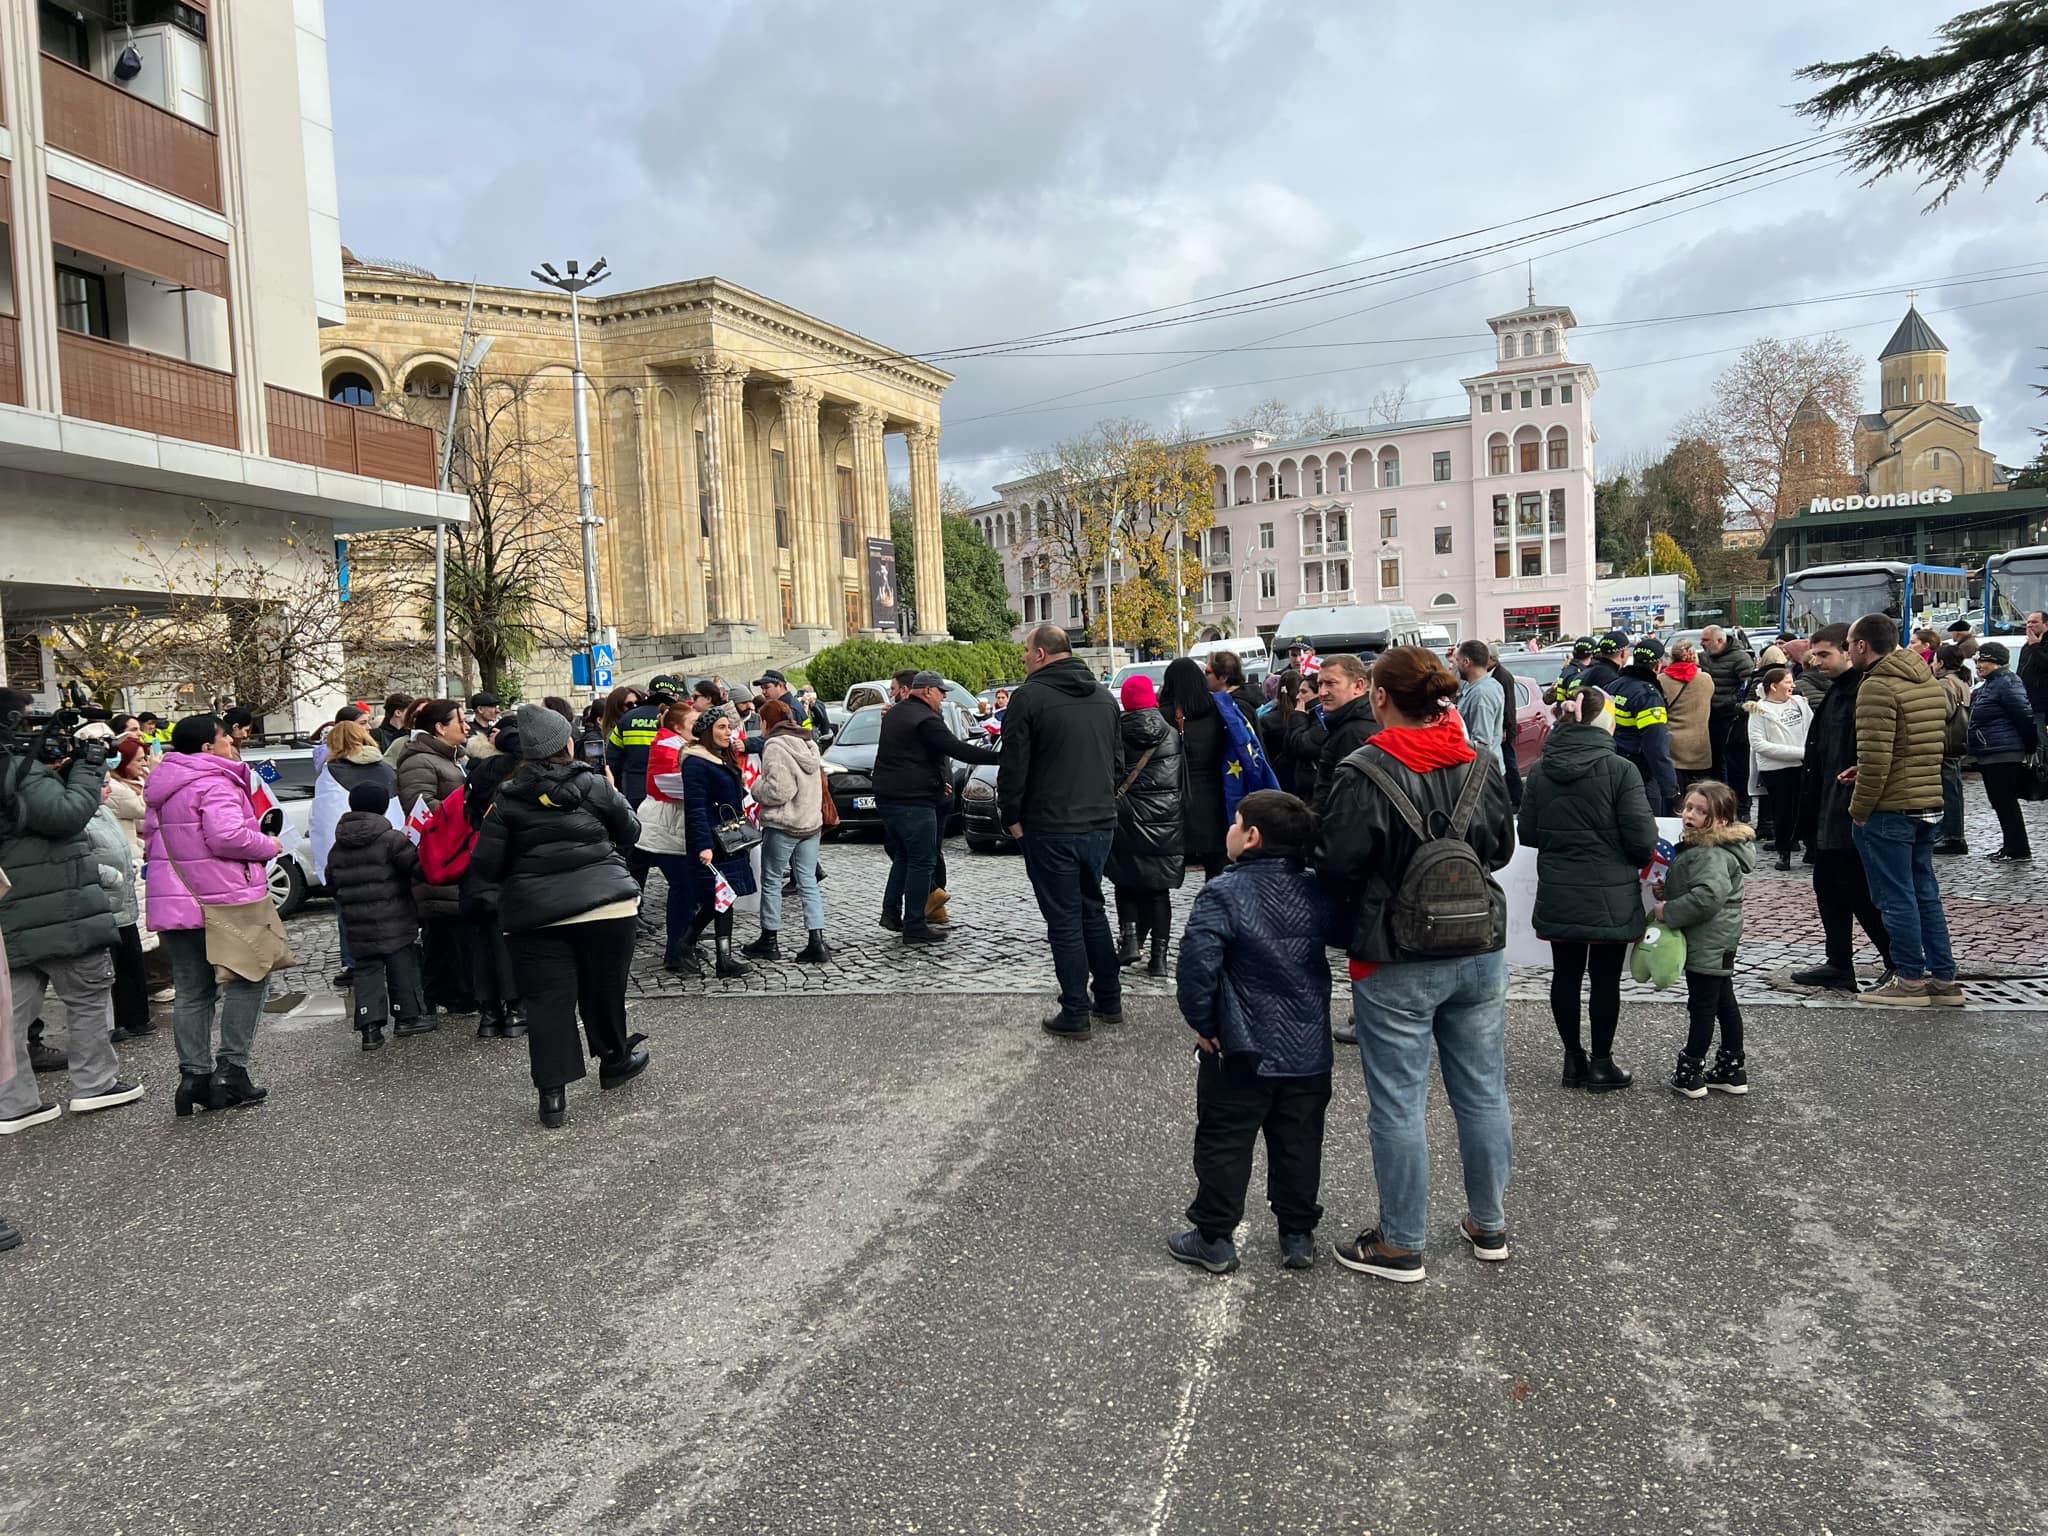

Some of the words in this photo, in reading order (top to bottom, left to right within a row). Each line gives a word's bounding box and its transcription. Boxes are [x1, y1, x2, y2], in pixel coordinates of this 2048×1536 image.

[1810, 488, 1952, 513] McDonald's
[598, 671, 608, 686] P
[655, 681, 676, 691] POLICE
[631, 718, 659, 728] POLIC
